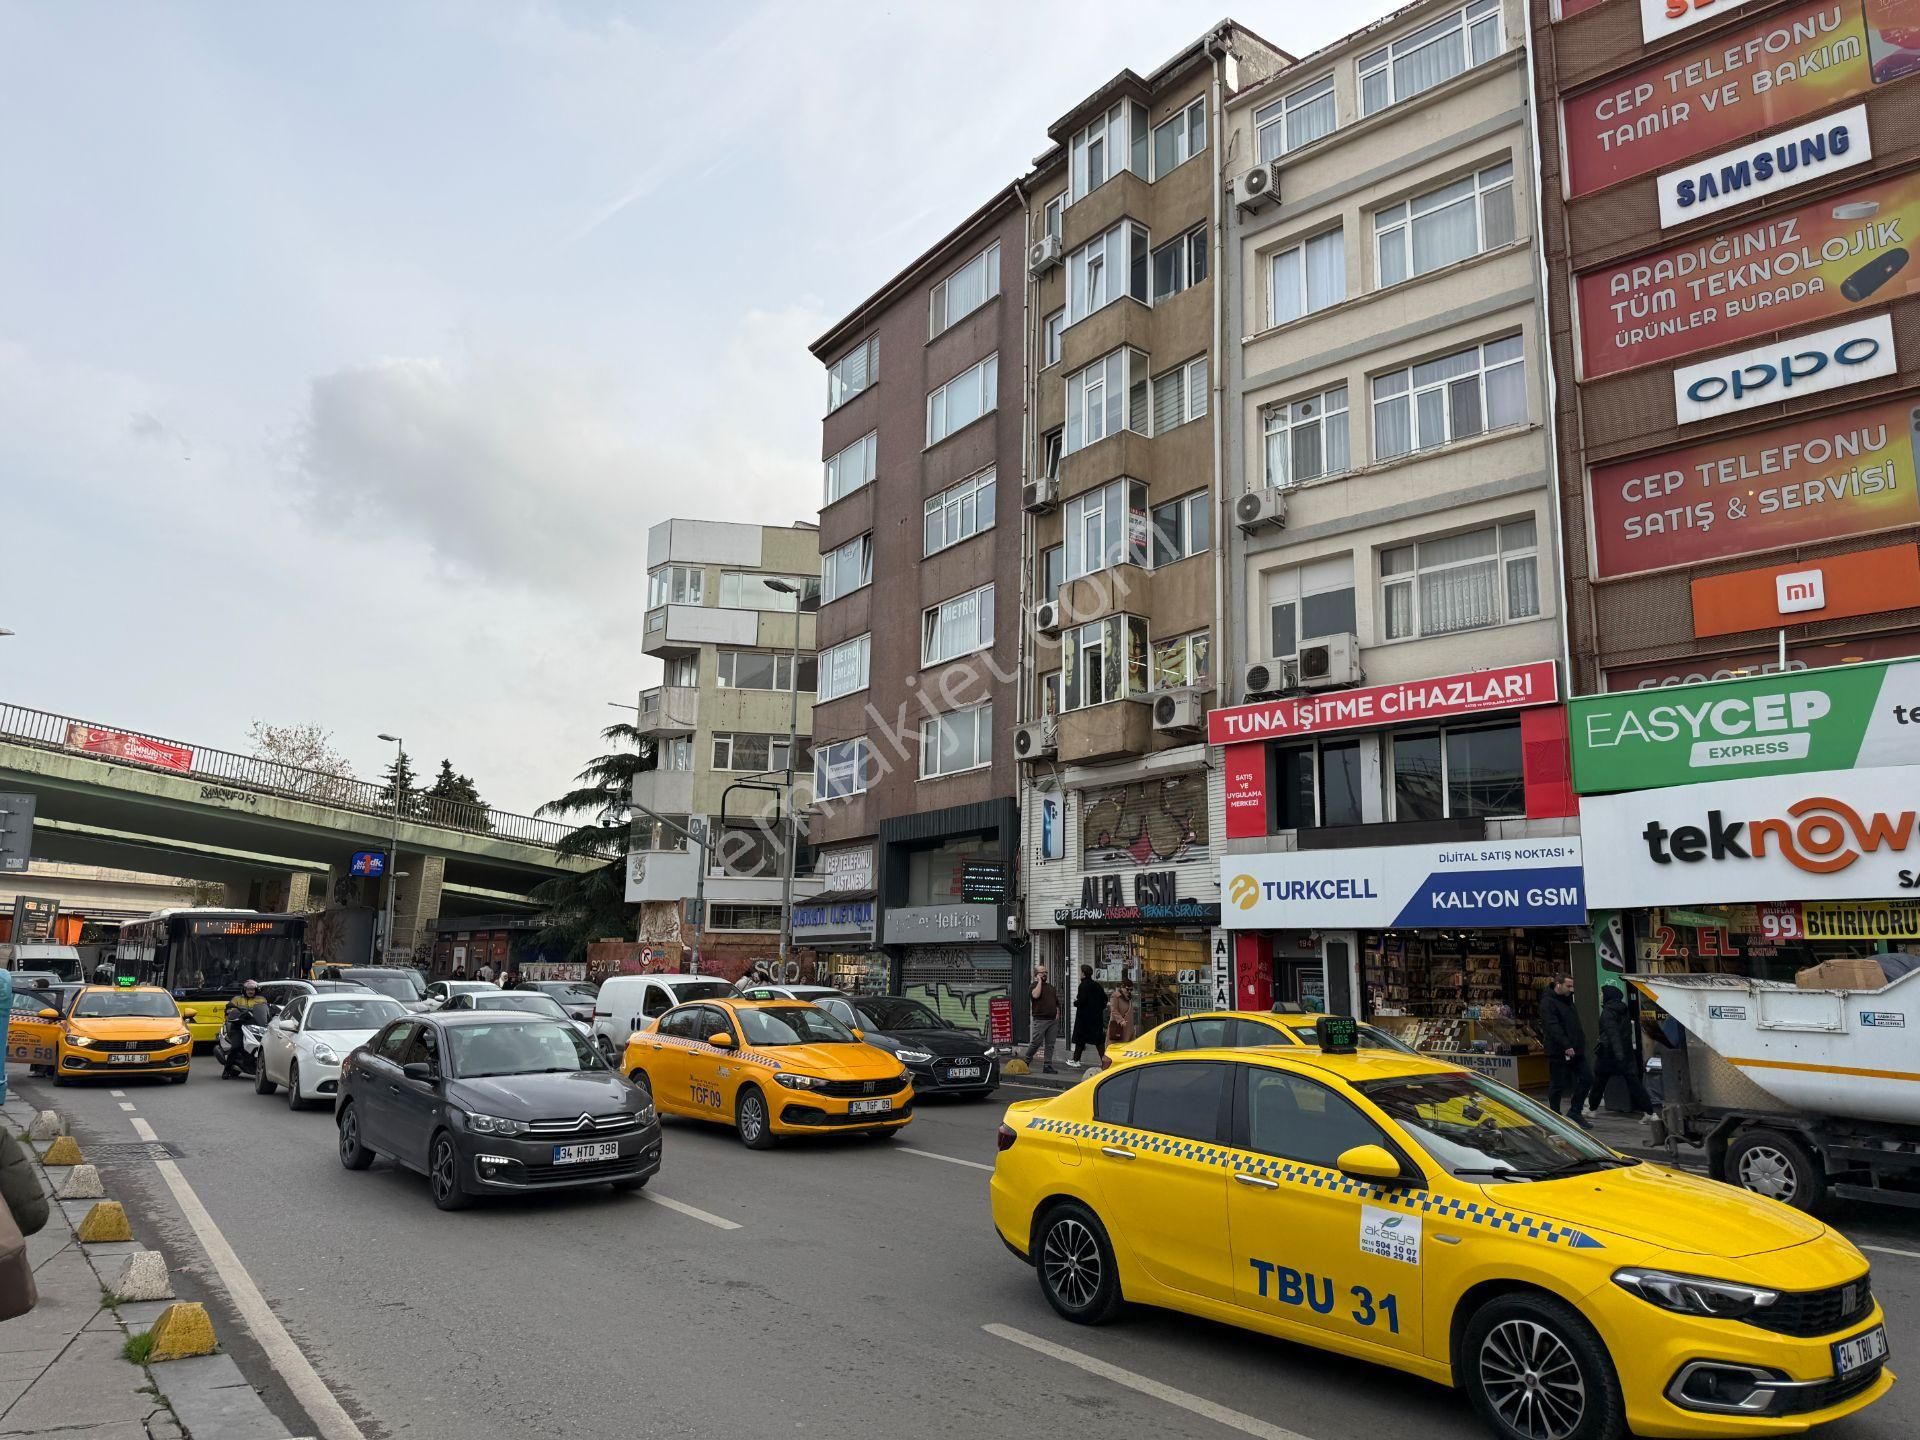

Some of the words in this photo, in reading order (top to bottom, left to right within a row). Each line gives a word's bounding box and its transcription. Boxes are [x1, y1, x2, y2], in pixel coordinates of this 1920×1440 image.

[1596, 83, 1655, 121] CEP
[1663, 6, 1842, 93] TELEFONU
[1597, 102, 1690, 152] TAMİR
[1700, 81, 1740, 113] VE
[1752, 36, 1861, 95] BAKIM
[1676, 125, 1850, 207] SAMSUNG
[1610, 217, 1800, 297] ARADIĞINIZ
[1610, 288, 1676, 324] TÜM
[1687, 219, 1904, 301] TEKNOLOJİK
[1615, 308, 1718, 348] ÜRÜNLER
[1725, 277, 1824, 317] BURADA
[1622, 470, 1685, 502] CEP
[1695, 425, 1888, 487] TELEFONU
[1623, 502, 1715, 540] SATIŞ
[1726, 497, 1747, 520] &
[1758, 460, 1897, 514] SERVİSİ
[1224, 710, 1287, 735] TUNA
[1293, 695, 1374, 731] İŞİTME
[1380, 672, 1532, 714] CİHAZLARI
[1587, 690, 1831, 748] EASYCEP
[1709, 741, 1789, 759] EXPRESS
[1480, 850, 1512, 861] SATIŞ
[1515, 848, 1565, 859] NOKTASI
[1081, 873, 1124, 908] ALFA
[1135, 871, 1177, 906] GSM
[1263, 879, 1377, 900] TURKCELL
[1432, 889, 1519, 909] KALYON
[1526, 887, 1578, 906] GSM
[1807, 905, 1920, 935] BİTİRİYORU
[1655, 926, 1689, 957] 2.
[1697, 926, 1740, 957] EL
[690, 1085, 709, 1104] TGF
[710, 1090, 721, 1108] 09
[854, 1102, 862, 1111] 34
[866, 1101, 878, 1110] TGF
[881, 1100, 890, 1109] 09
[561, 1148, 573, 1158] 34
[577, 1146, 594, 1157] HTD
[600, 1143, 616, 1155] 398
[1365, 1225, 1415, 1246] akasya
[1375, 1241, 1390, 1250] 504
[1394, 1245, 1404, 1253] 10
[1406, 1248, 1417, 1257] 07
[1376, 1248, 1390, 1257] 409
[1394, 1252, 1404, 1260] 29
[1249, 1258, 1335, 1315] TBU
[1350, 1285, 1400, 1335] 31
[1840, 1345, 1853, 1370] 34
[1856, 1336, 1873, 1364] TBU
